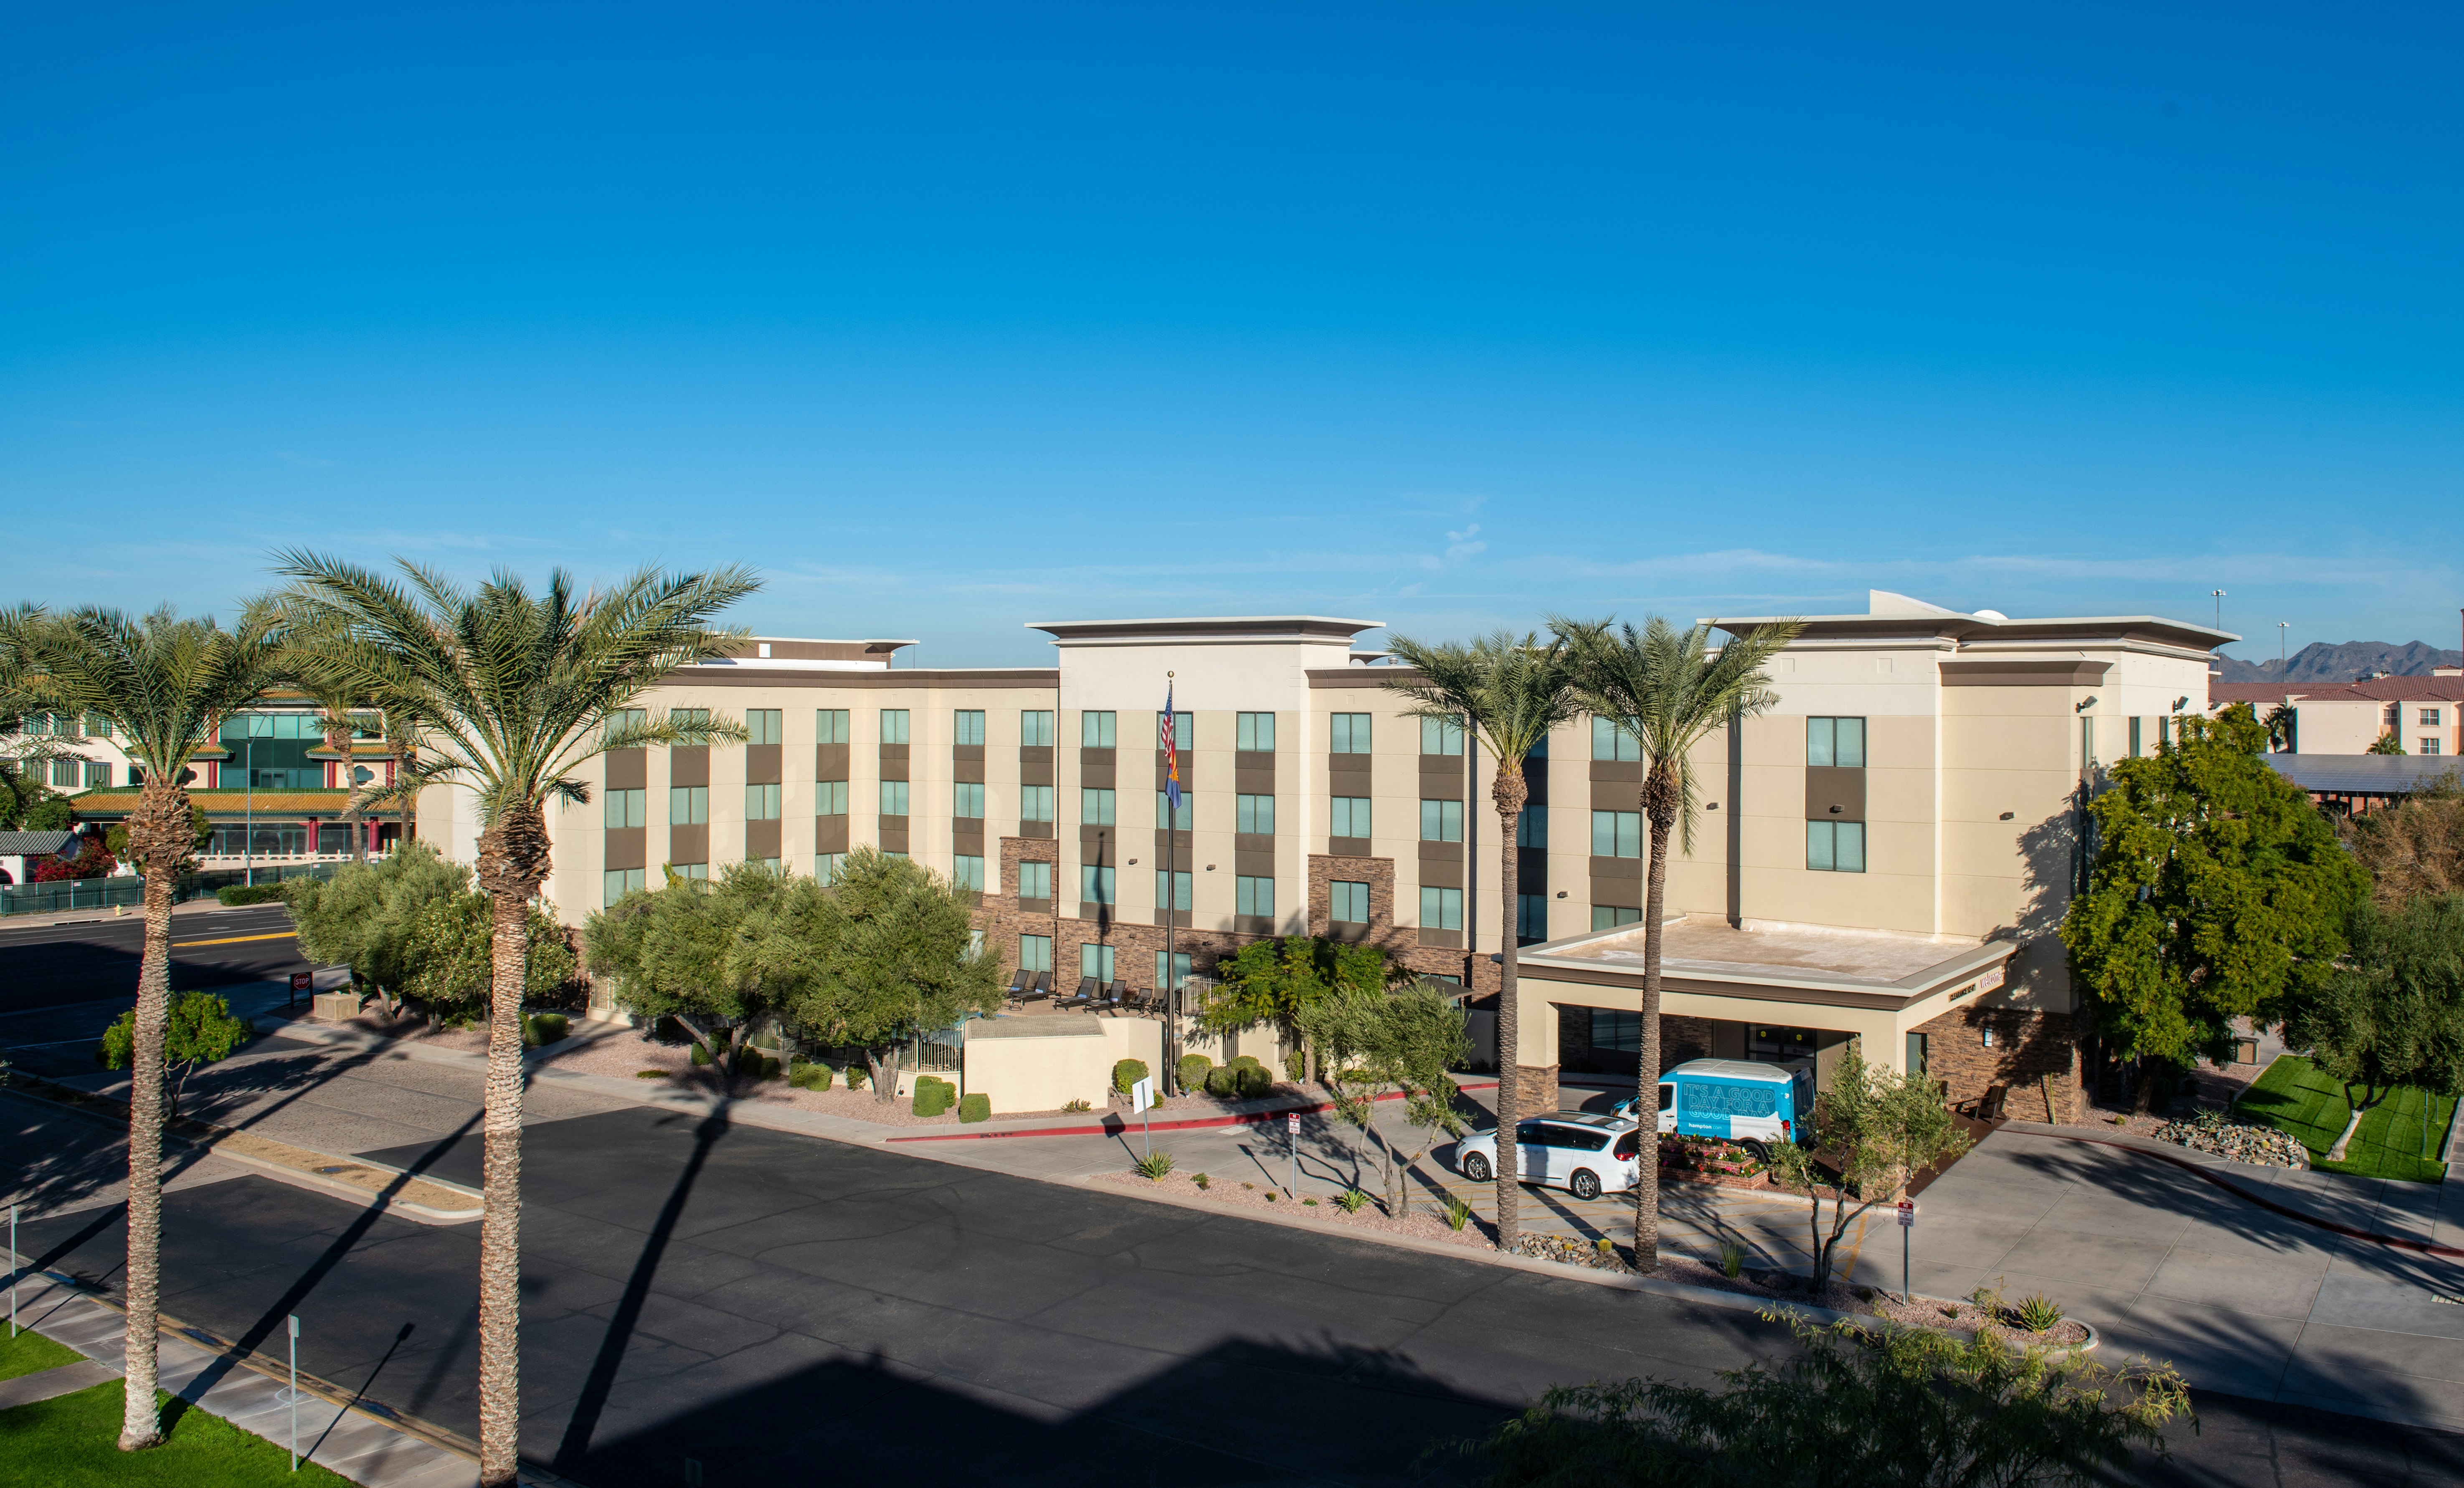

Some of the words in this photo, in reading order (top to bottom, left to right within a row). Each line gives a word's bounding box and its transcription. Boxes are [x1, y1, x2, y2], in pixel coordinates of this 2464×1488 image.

[1950, 988, 1967, 1001] CLEARANCE
[1683, 1083, 1709, 1097] IT'S
[1713, 1086, 1724, 1098] A
[1729, 1087, 1775, 1103] GOOD
[1689, 1094, 1719, 1108] DAY
[1724, 1098, 1753, 1112] FOR
[1757, 1100, 1770, 1113] A
[1688, 1105, 1733, 1120] GOOD
